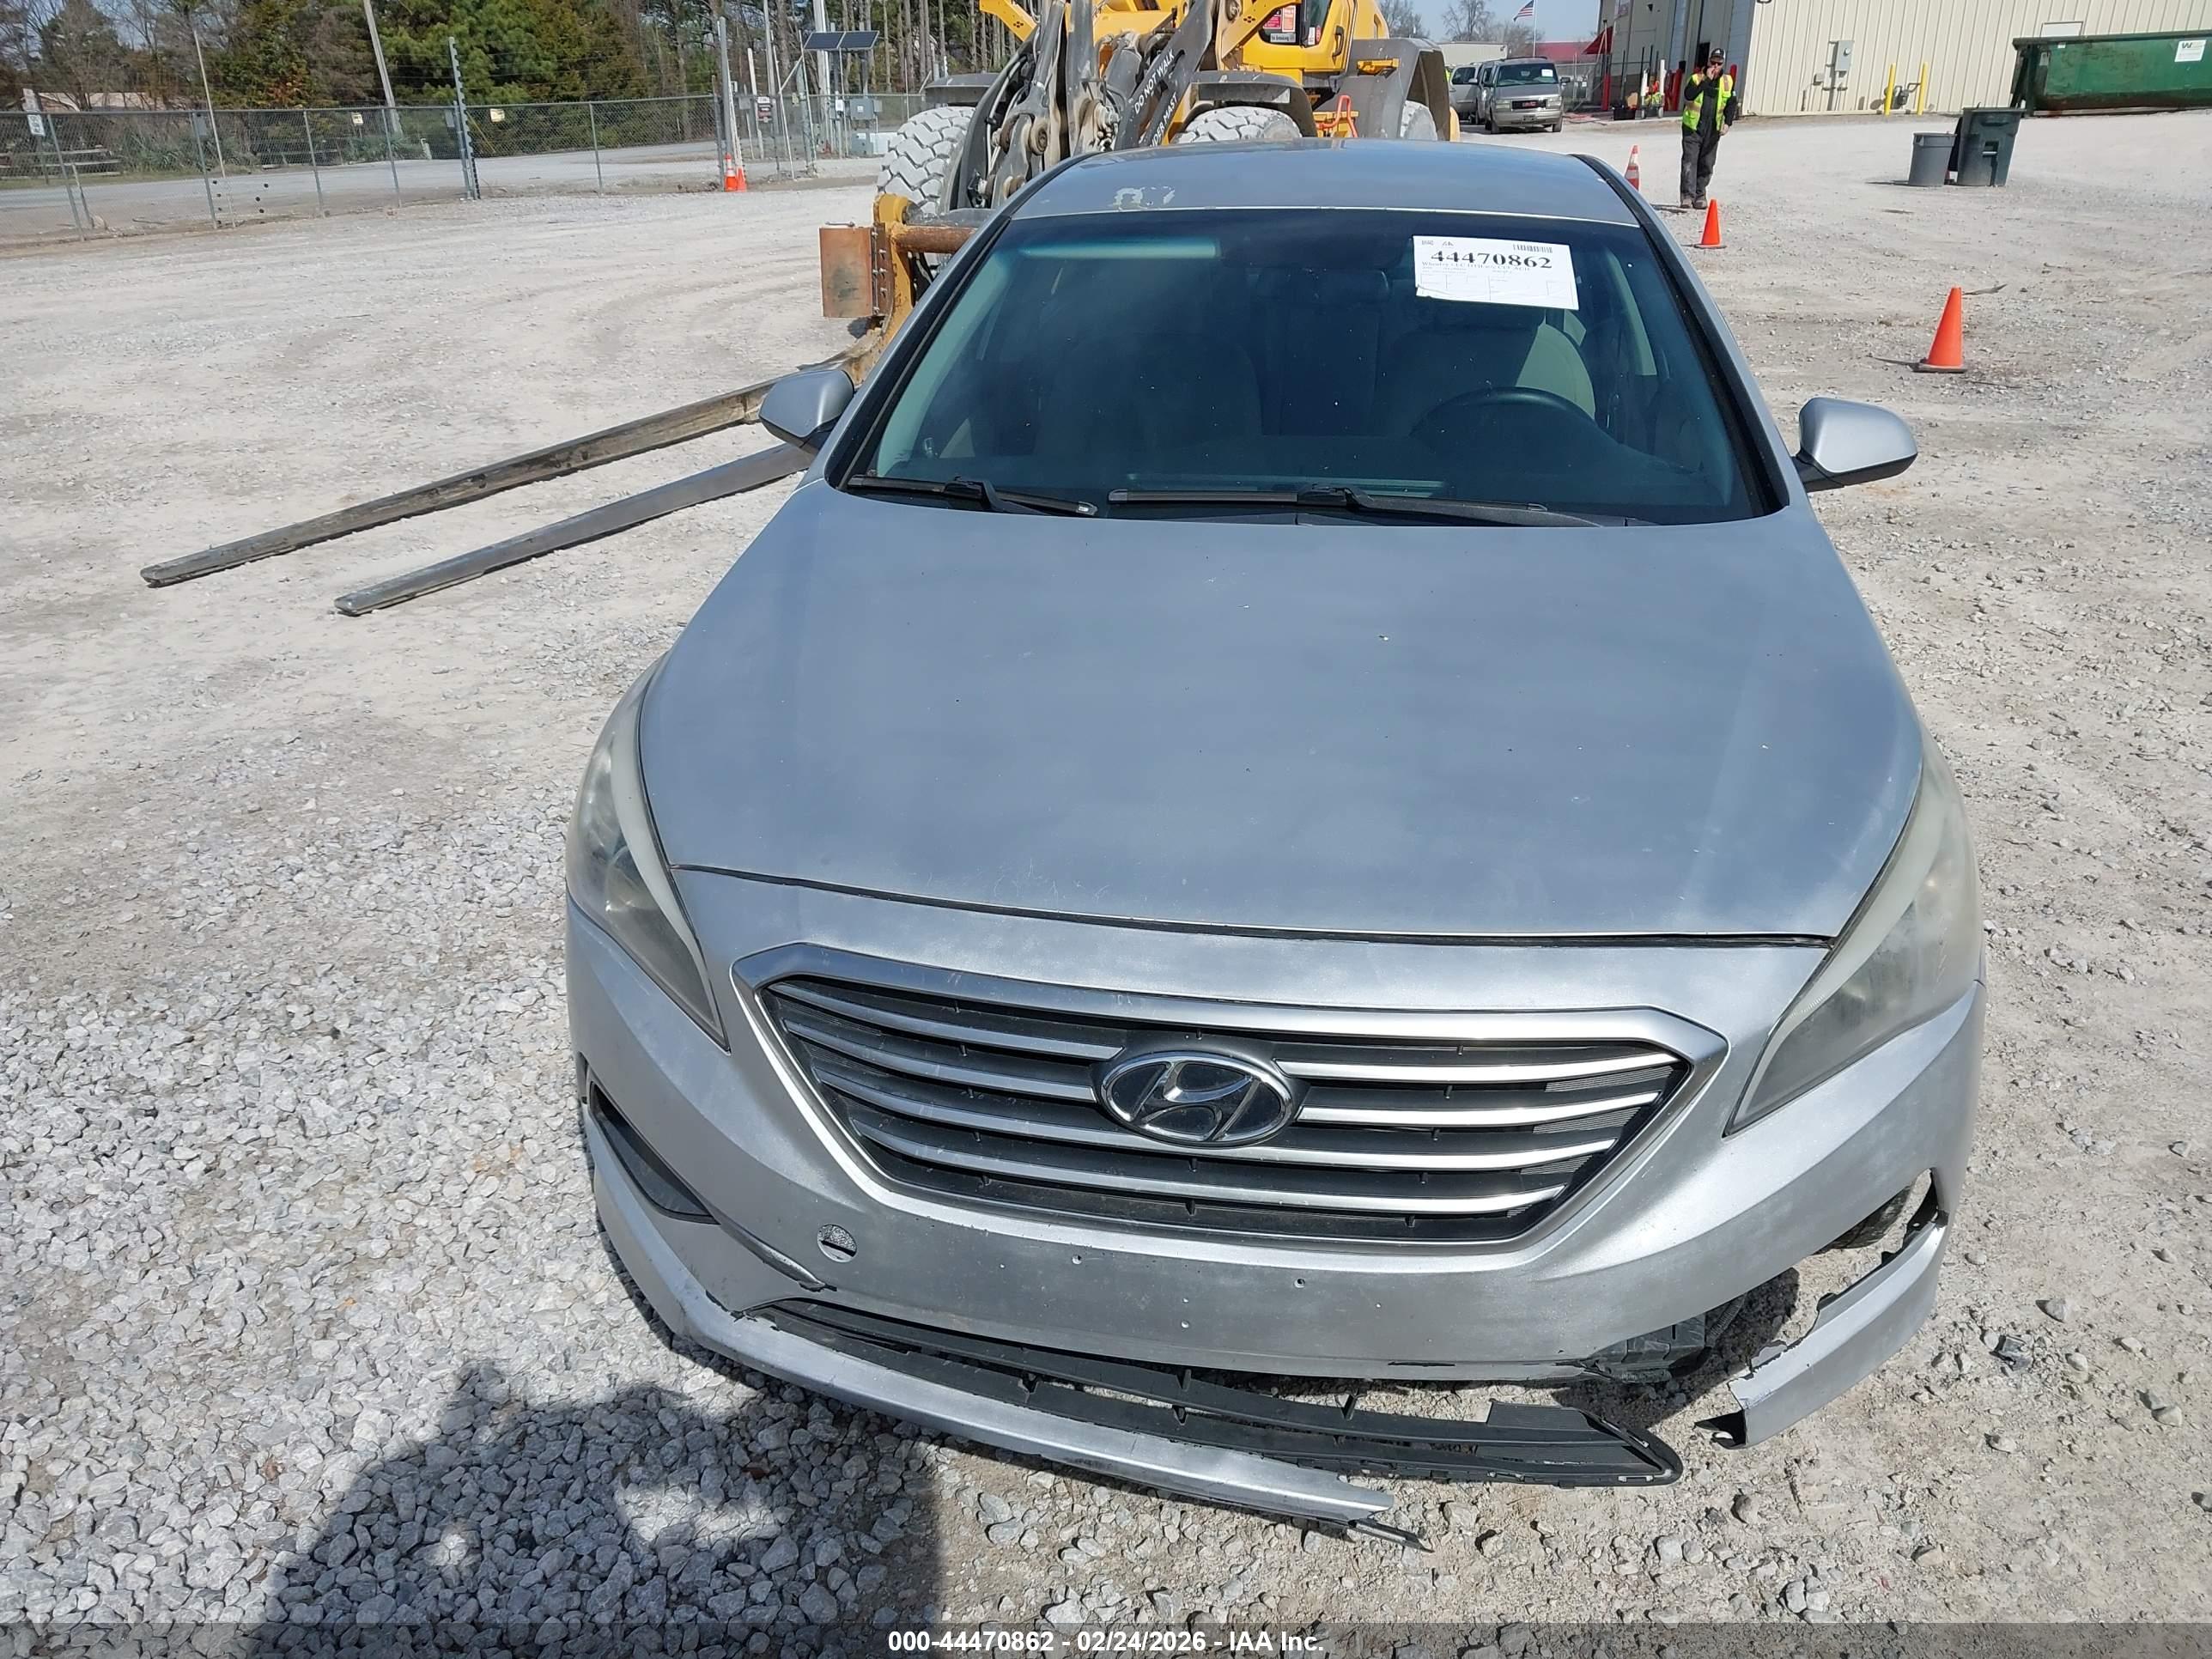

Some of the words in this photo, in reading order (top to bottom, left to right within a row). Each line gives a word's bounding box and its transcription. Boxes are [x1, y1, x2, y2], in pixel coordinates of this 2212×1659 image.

[1134, 95, 1145, 114] DO
[1144, 72, 1158, 99] NOT
[1157, 49, 1175, 78] WALK
[1163, 91, 1178, 122] MAST
[1431, 250, 1553, 269] 44470862
